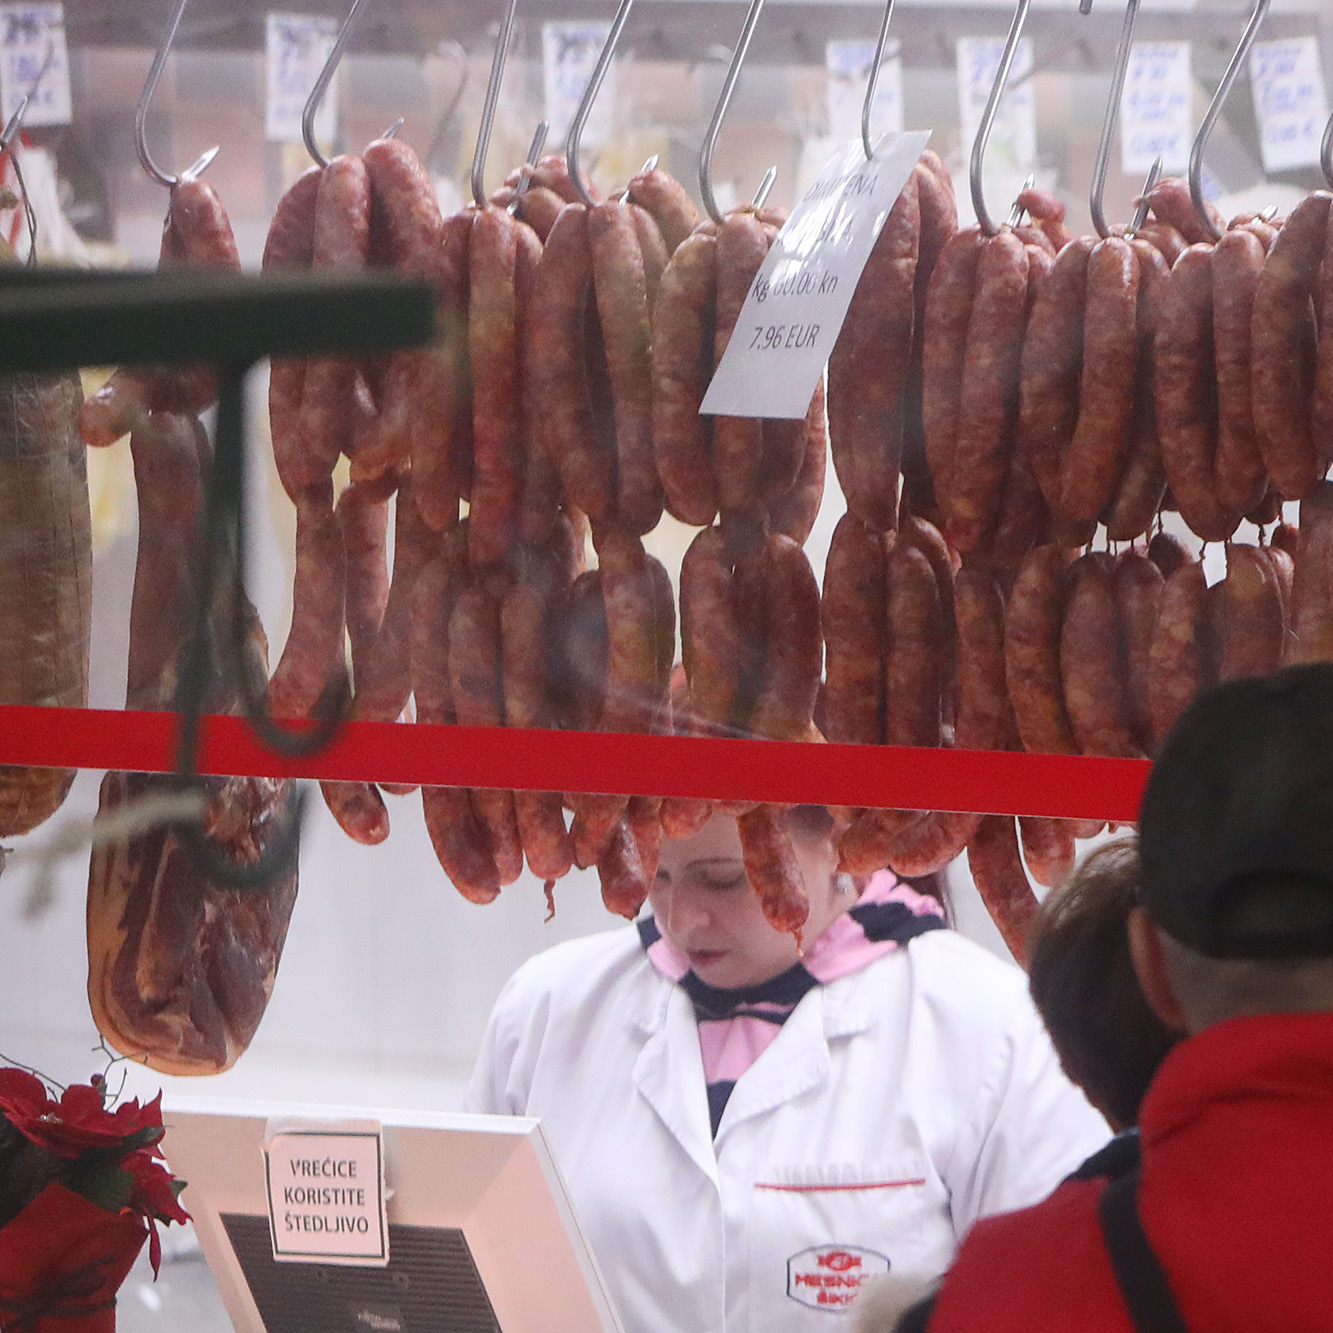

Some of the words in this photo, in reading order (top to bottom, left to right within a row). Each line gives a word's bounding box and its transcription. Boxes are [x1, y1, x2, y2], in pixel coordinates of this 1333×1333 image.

[751, 273, 770, 304] kg
[818, 269, 839, 294] kn
[749, 324, 786, 350] 7.96
[784, 323, 820, 349] EUR
[284, 1185, 366, 1207] KORISTITE
[284, 1210, 370, 1233] ŠTEDLJIVO
